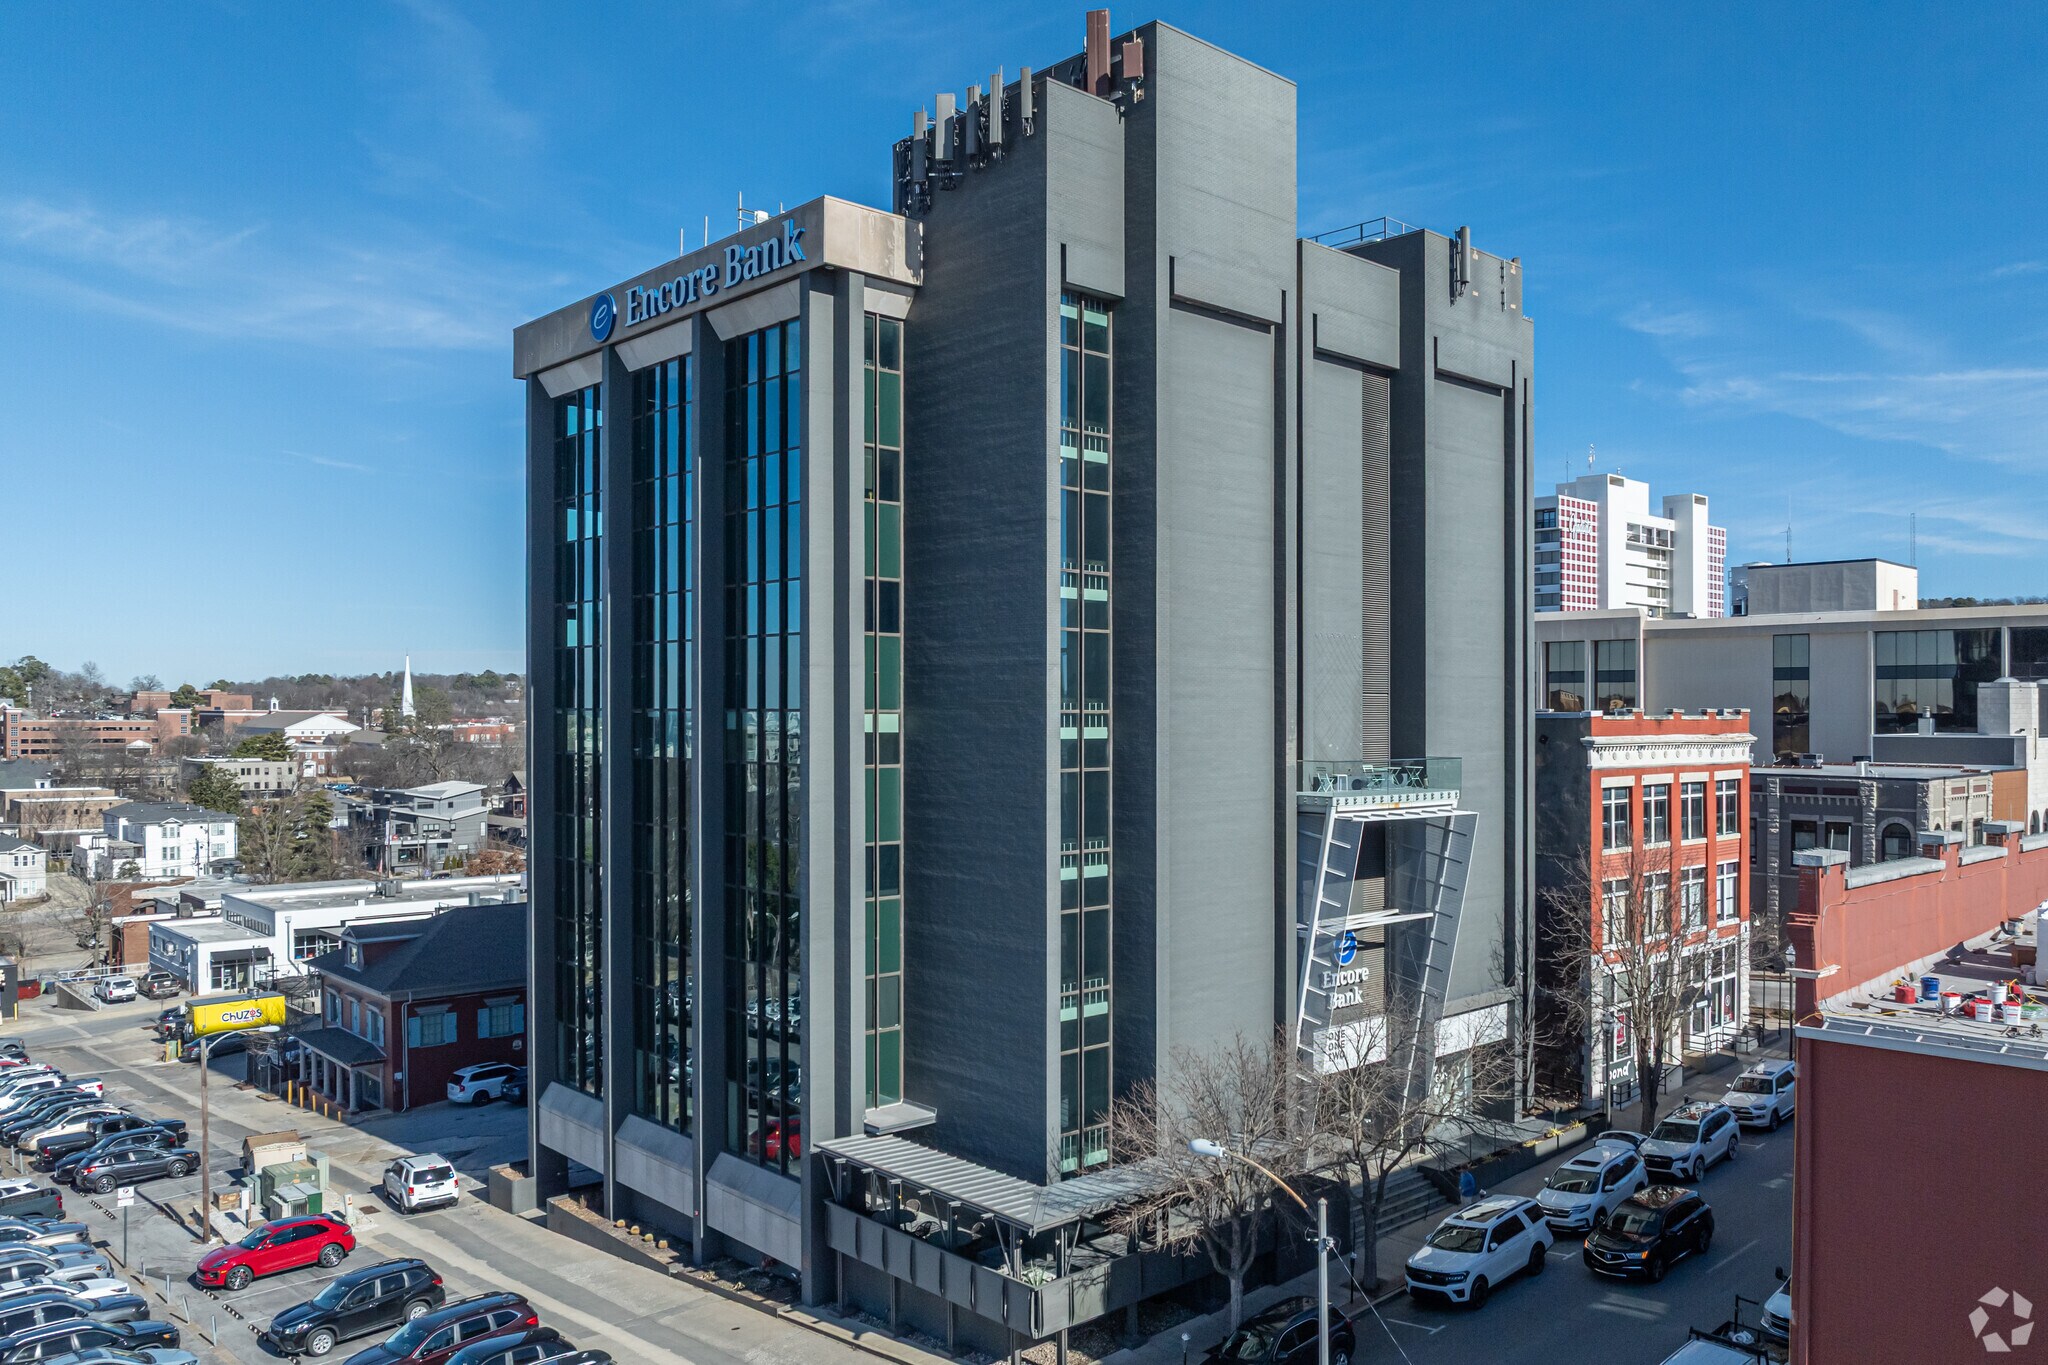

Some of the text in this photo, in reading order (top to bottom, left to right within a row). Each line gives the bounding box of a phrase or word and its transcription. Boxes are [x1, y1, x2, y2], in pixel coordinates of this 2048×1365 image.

[625, 219, 806, 327] Encore Bank
[1323, 967, 1369, 989] Encore
[1328, 986, 1363, 1009] Bank
[1328, 1029, 1346, 1041] ONE
[1328, 1039, 1346, 1052] ONE
[1328, 1050, 1346, 1062] TWO
